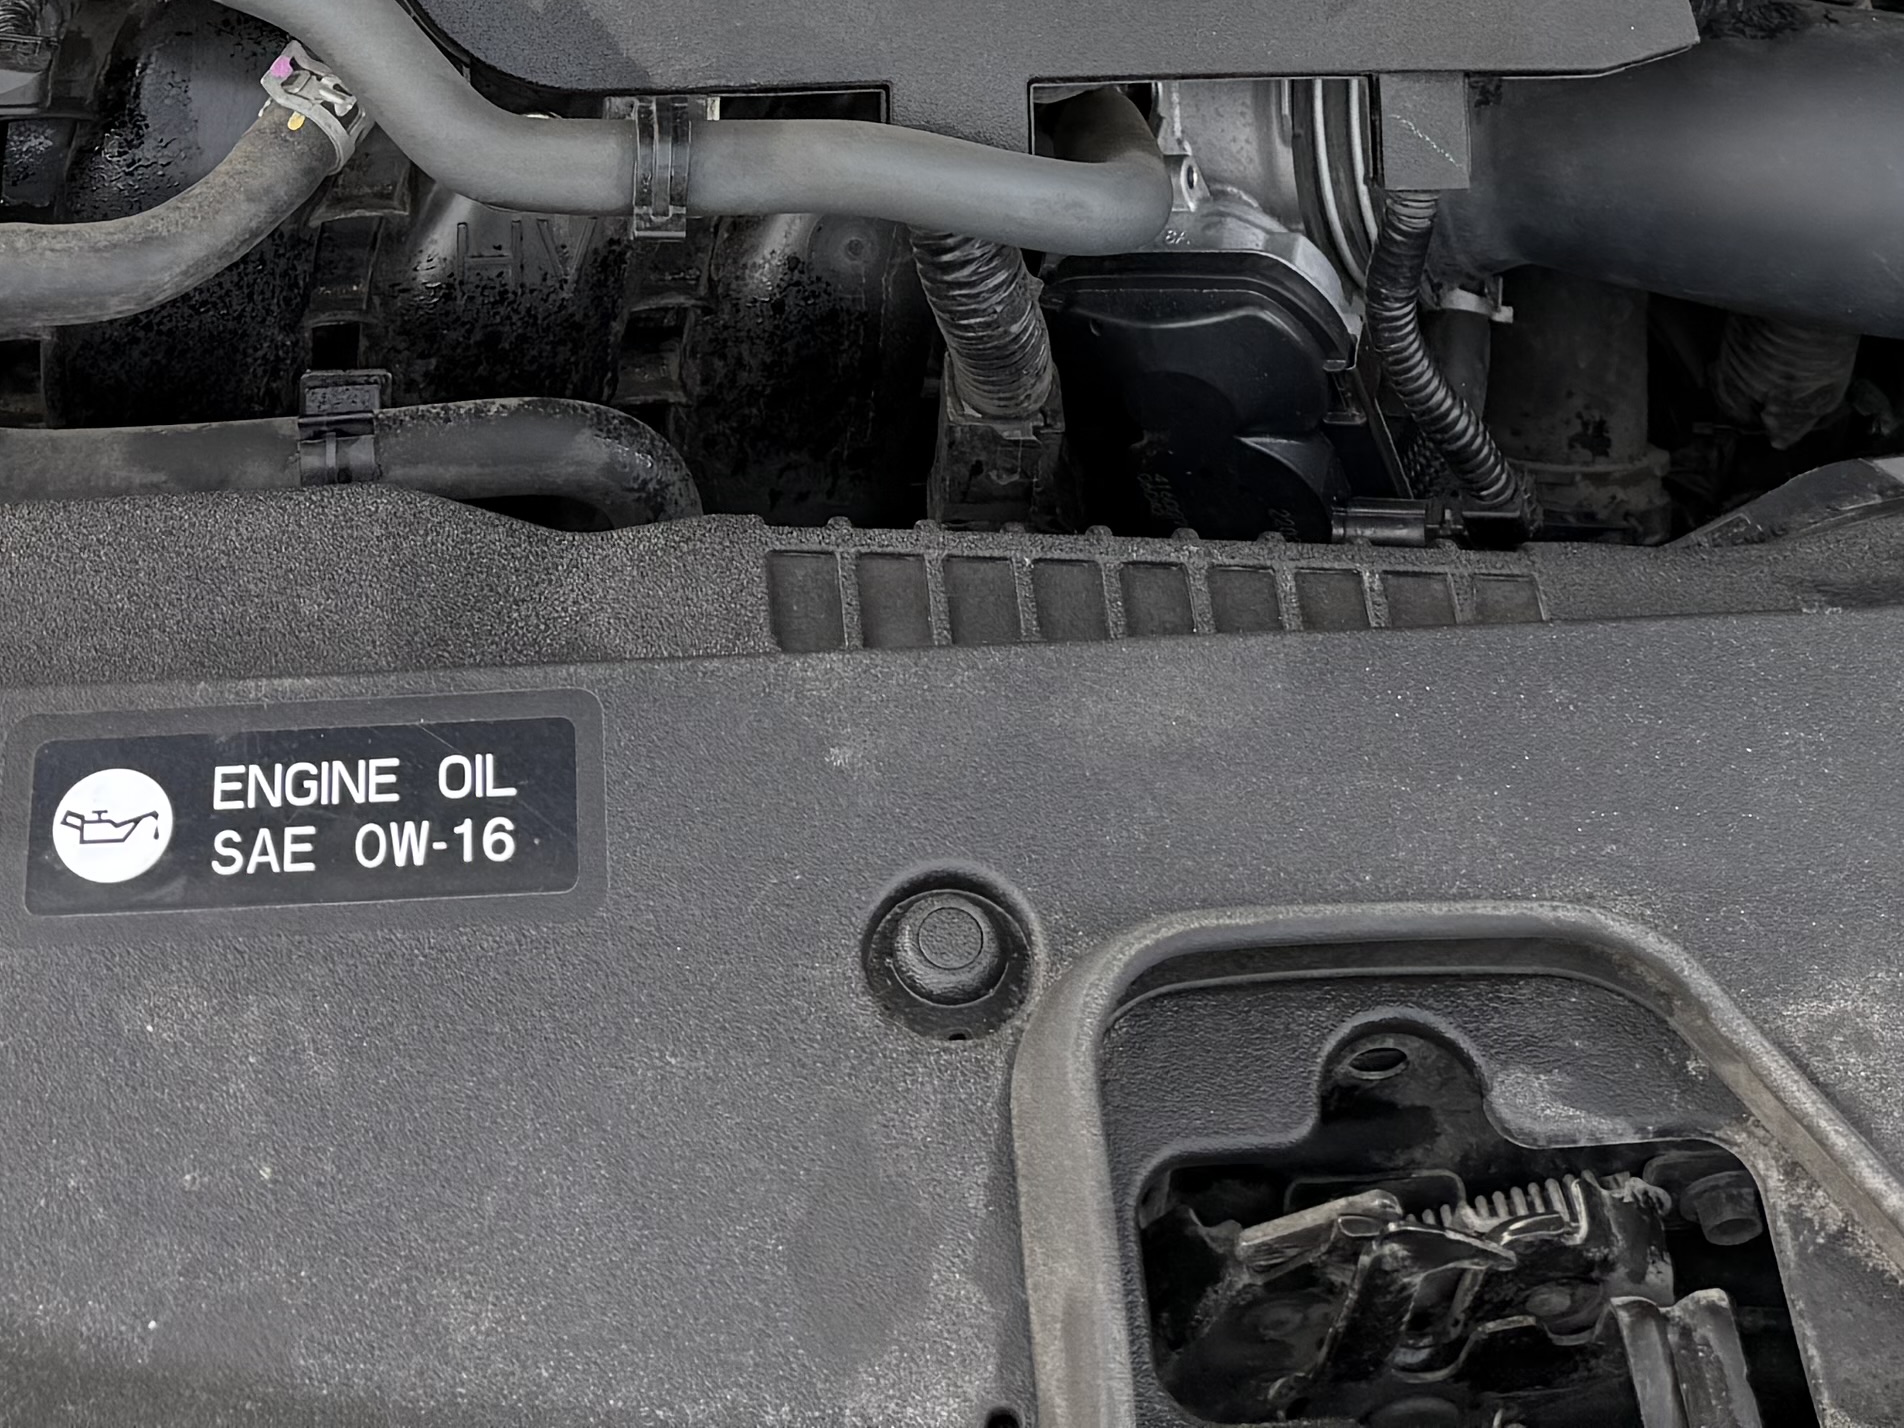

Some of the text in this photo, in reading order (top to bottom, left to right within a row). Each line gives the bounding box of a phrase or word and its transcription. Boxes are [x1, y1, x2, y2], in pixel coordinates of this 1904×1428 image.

[212, 753, 517, 811] ENGINE OIL
[211, 816, 516, 875] SAE 0W-16
